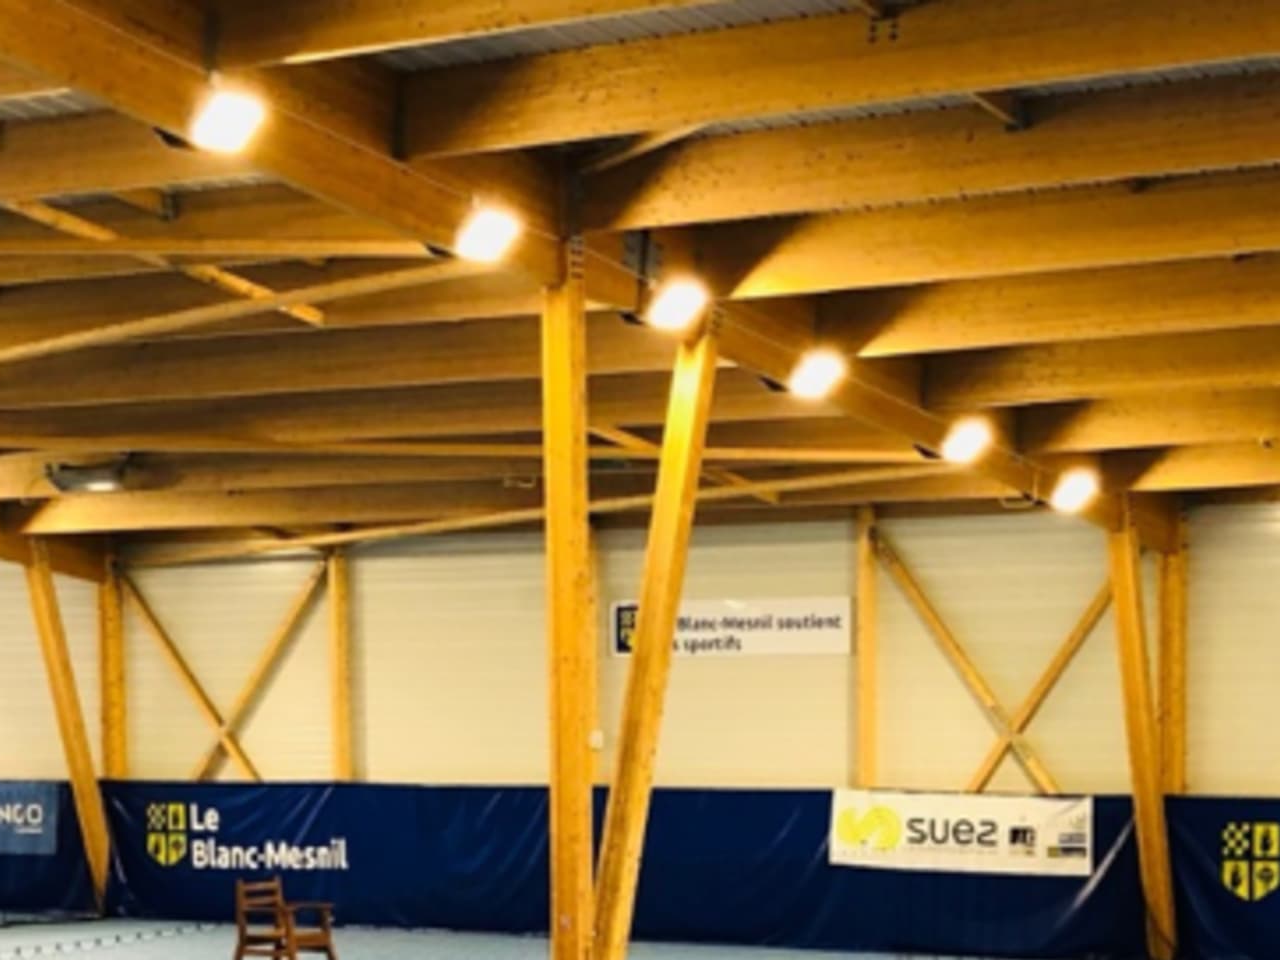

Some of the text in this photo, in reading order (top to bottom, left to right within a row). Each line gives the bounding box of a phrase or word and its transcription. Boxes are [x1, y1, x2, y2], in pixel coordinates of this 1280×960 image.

[777, 613, 842, 630] soutient
[684, 635, 742, 654] sportifs
[190, 803, 220, 832] Le
[191, 837, 349, 870] Blanc-Mesnil
